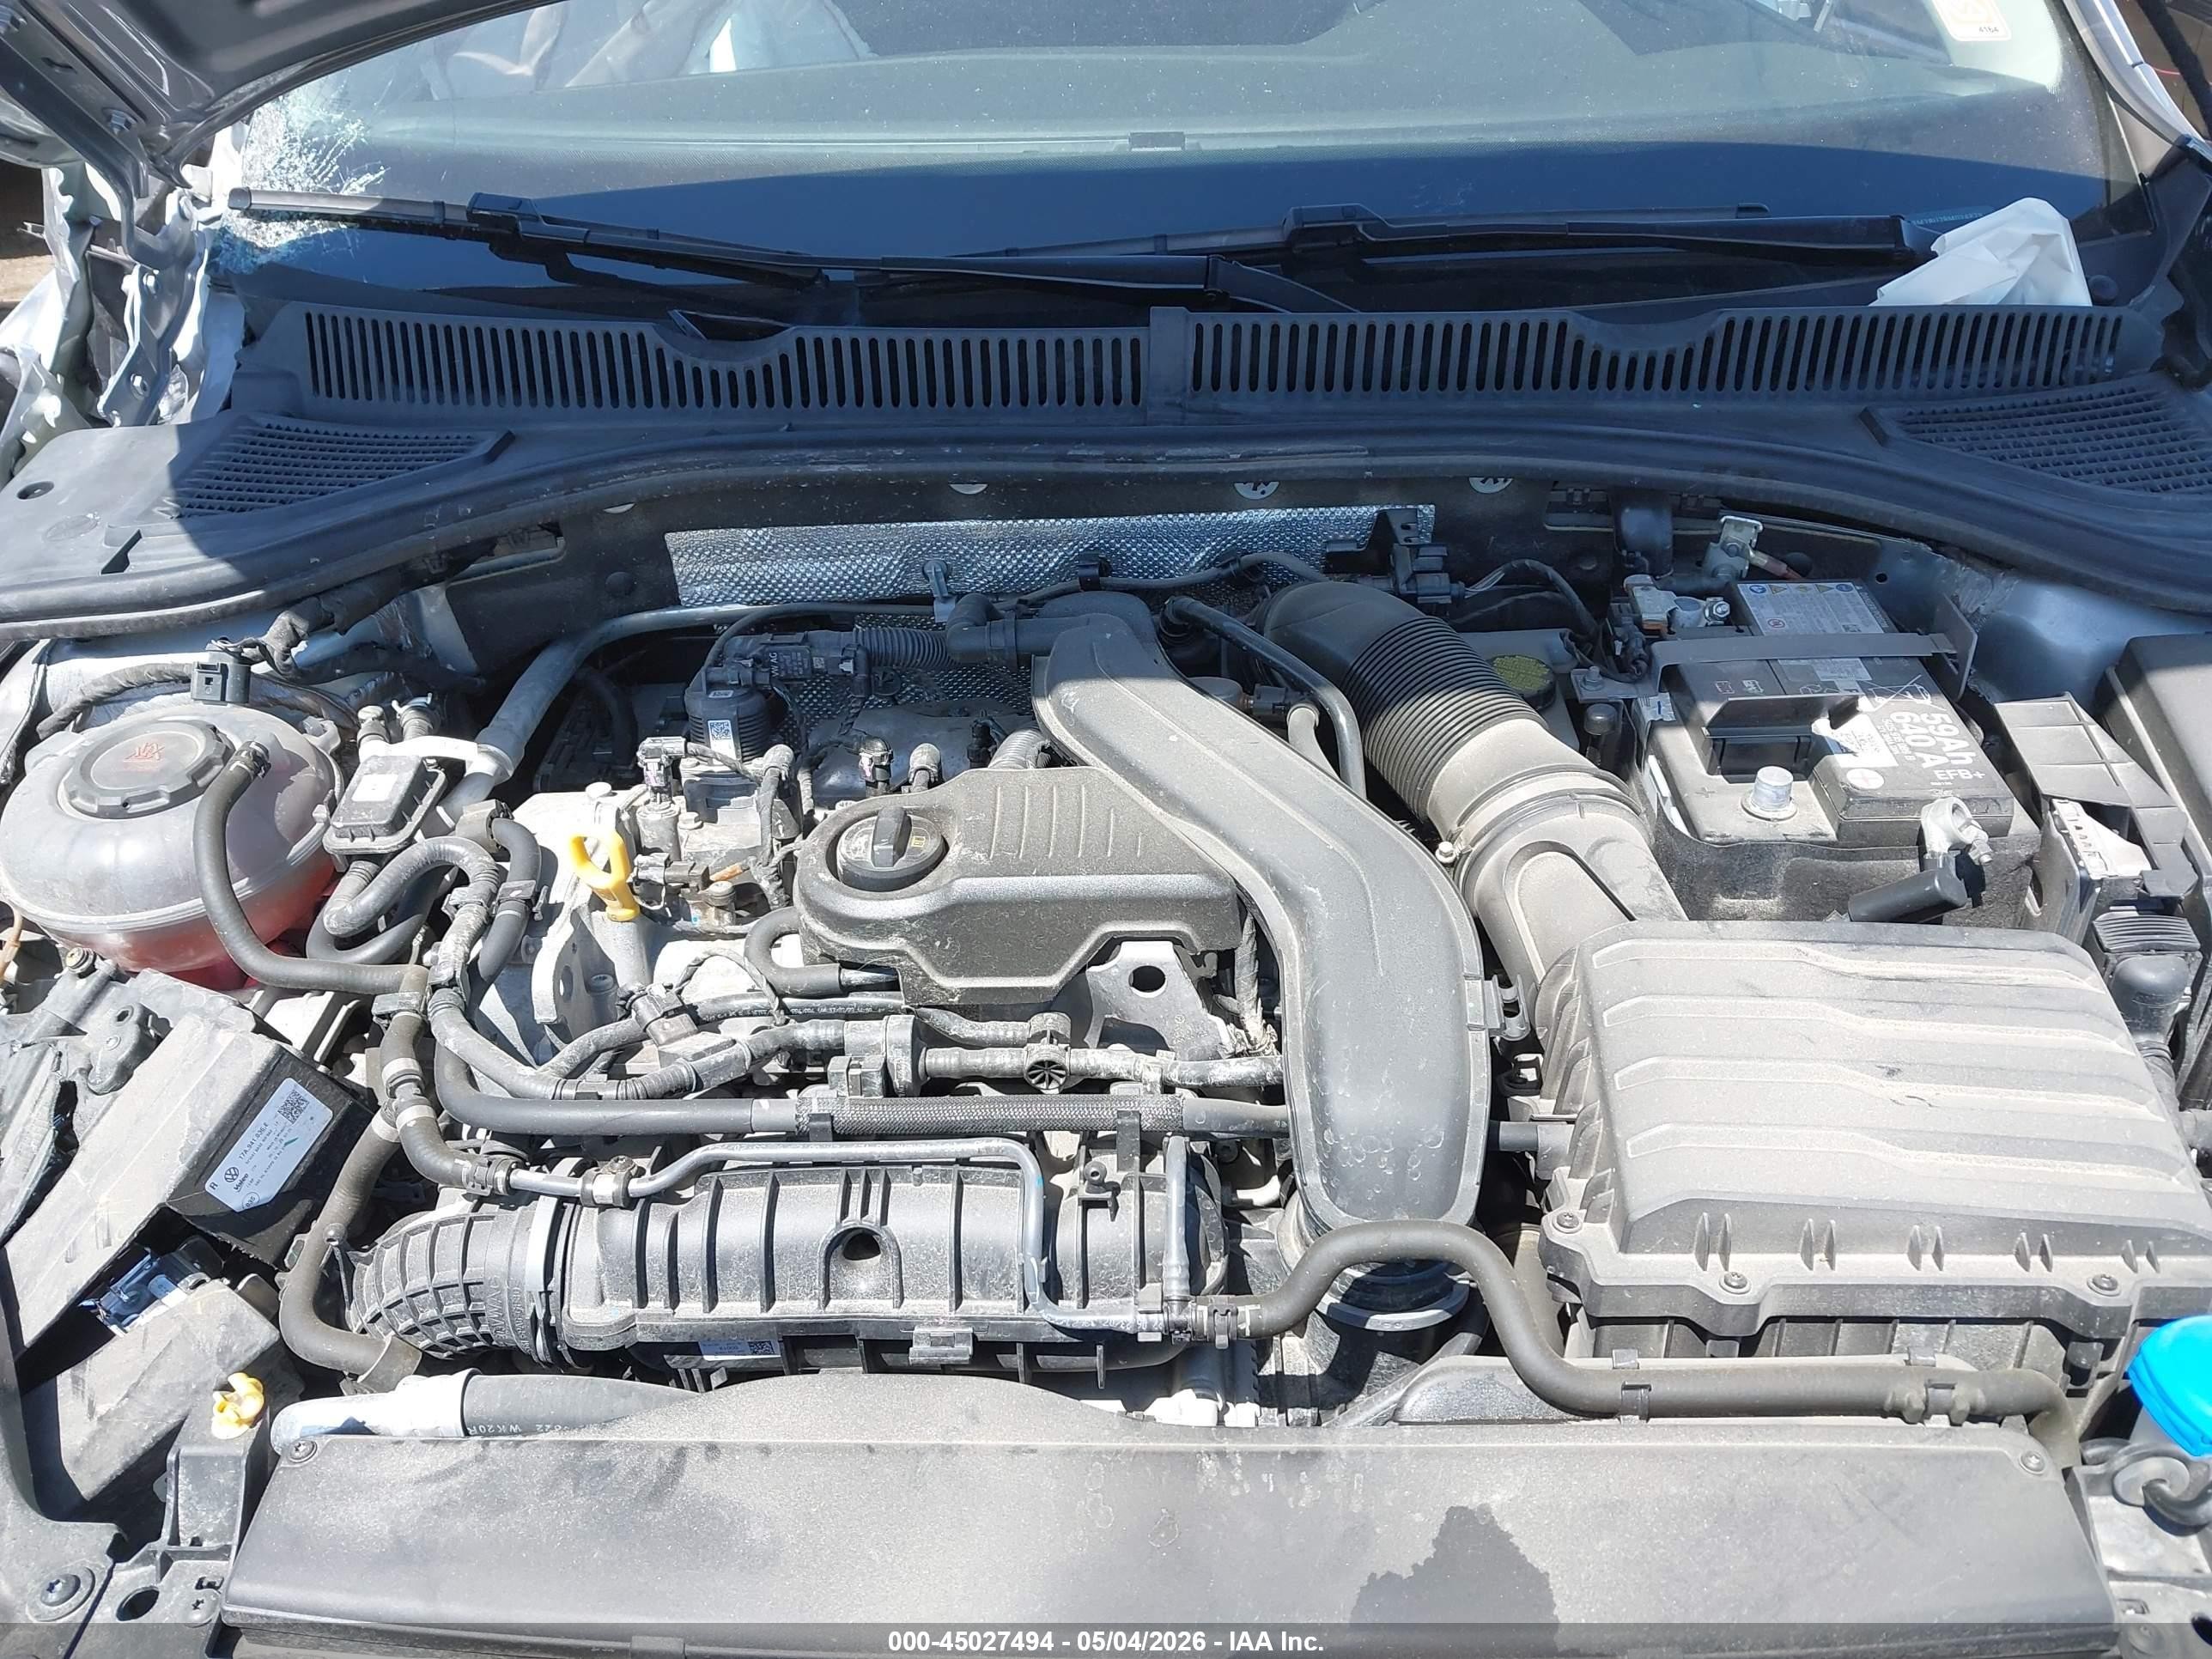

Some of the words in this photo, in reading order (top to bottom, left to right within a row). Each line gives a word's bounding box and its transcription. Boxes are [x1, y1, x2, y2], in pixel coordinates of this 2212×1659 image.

[1890, 711, 1936, 747] 640
[1914, 751, 1949, 769] A
[1920, 712, 1976, 765] 59Ah
[1934, 769, 1985, 780] EFB+
[210, 1182, 219, 1190] R
